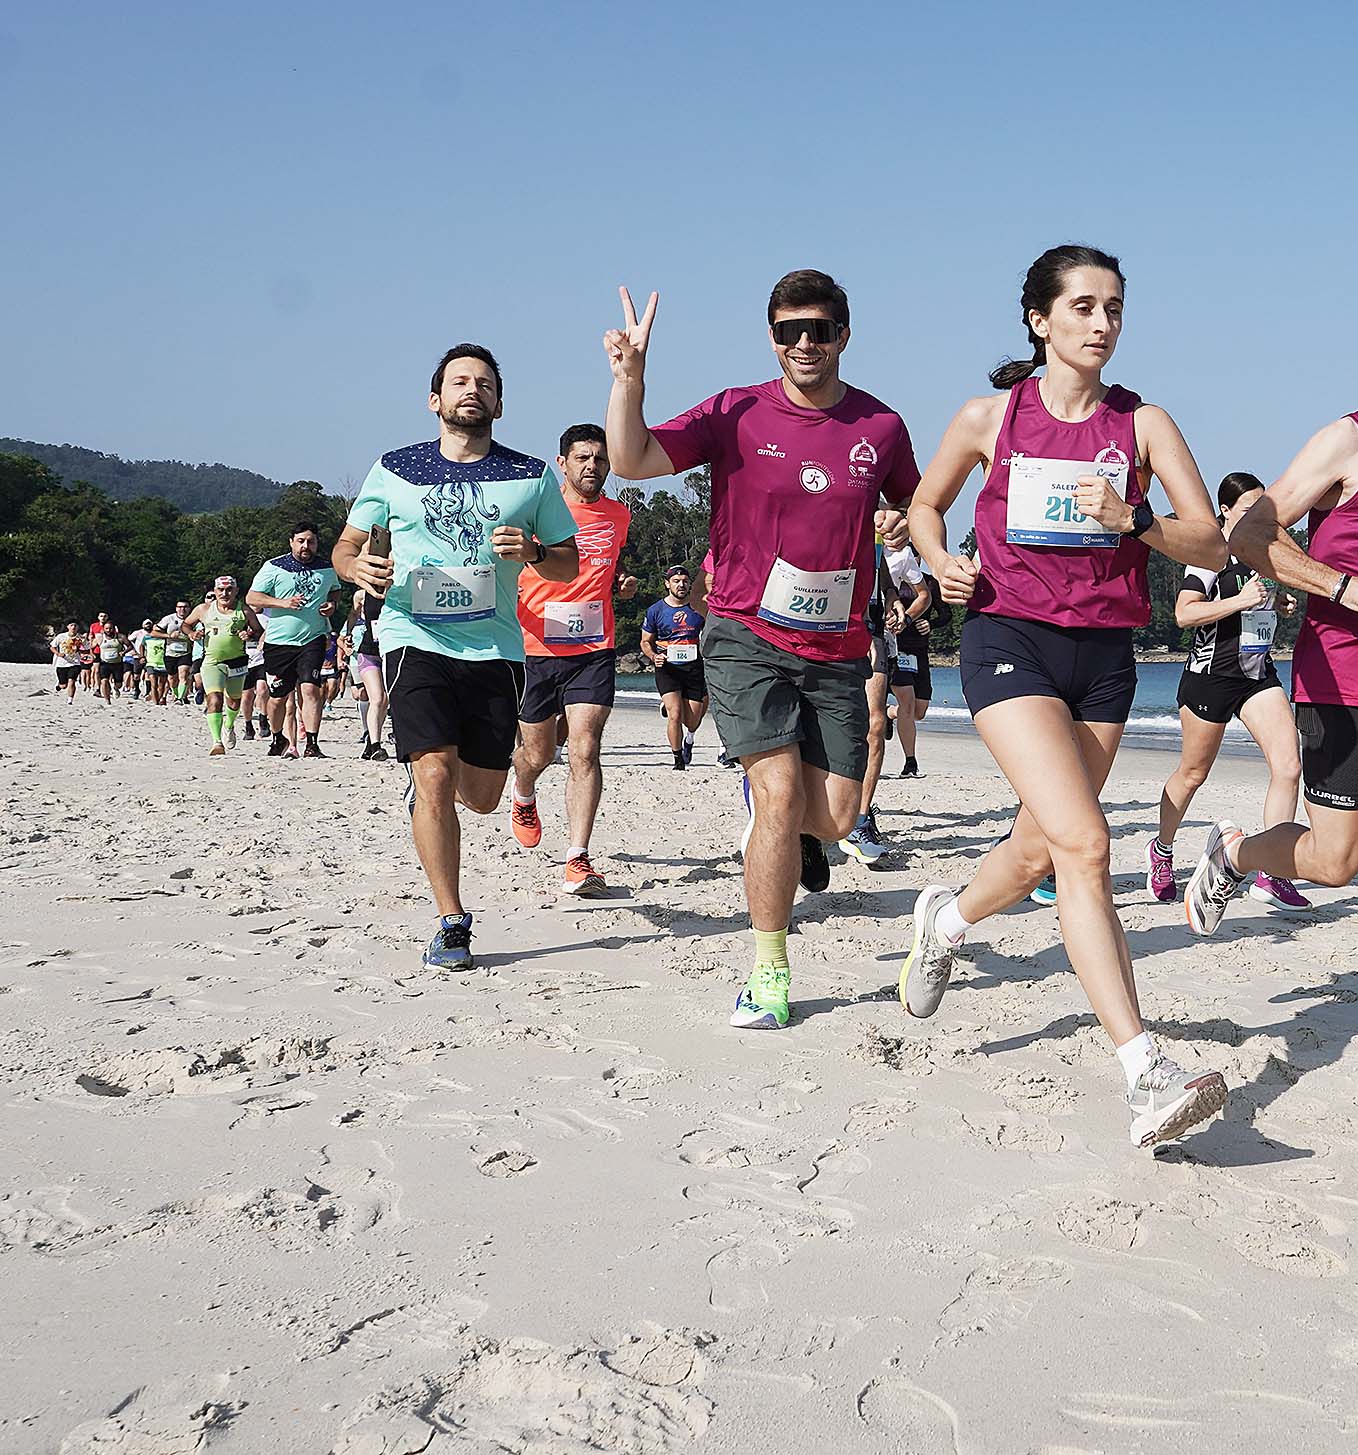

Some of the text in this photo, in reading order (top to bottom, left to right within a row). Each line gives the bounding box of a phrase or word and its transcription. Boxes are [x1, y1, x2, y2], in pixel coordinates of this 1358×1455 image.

[757, 448, 786, 458] amura
[793, 585, 829, 594] GUILLERMO
[435, 589, 473, 608] 288
[788, 595, 829, 616] 249
[568, 620, 585, 633] 78
[1257, 628, 1271, 641] 106
[1310, 788, 1356, 803] LURBEL
